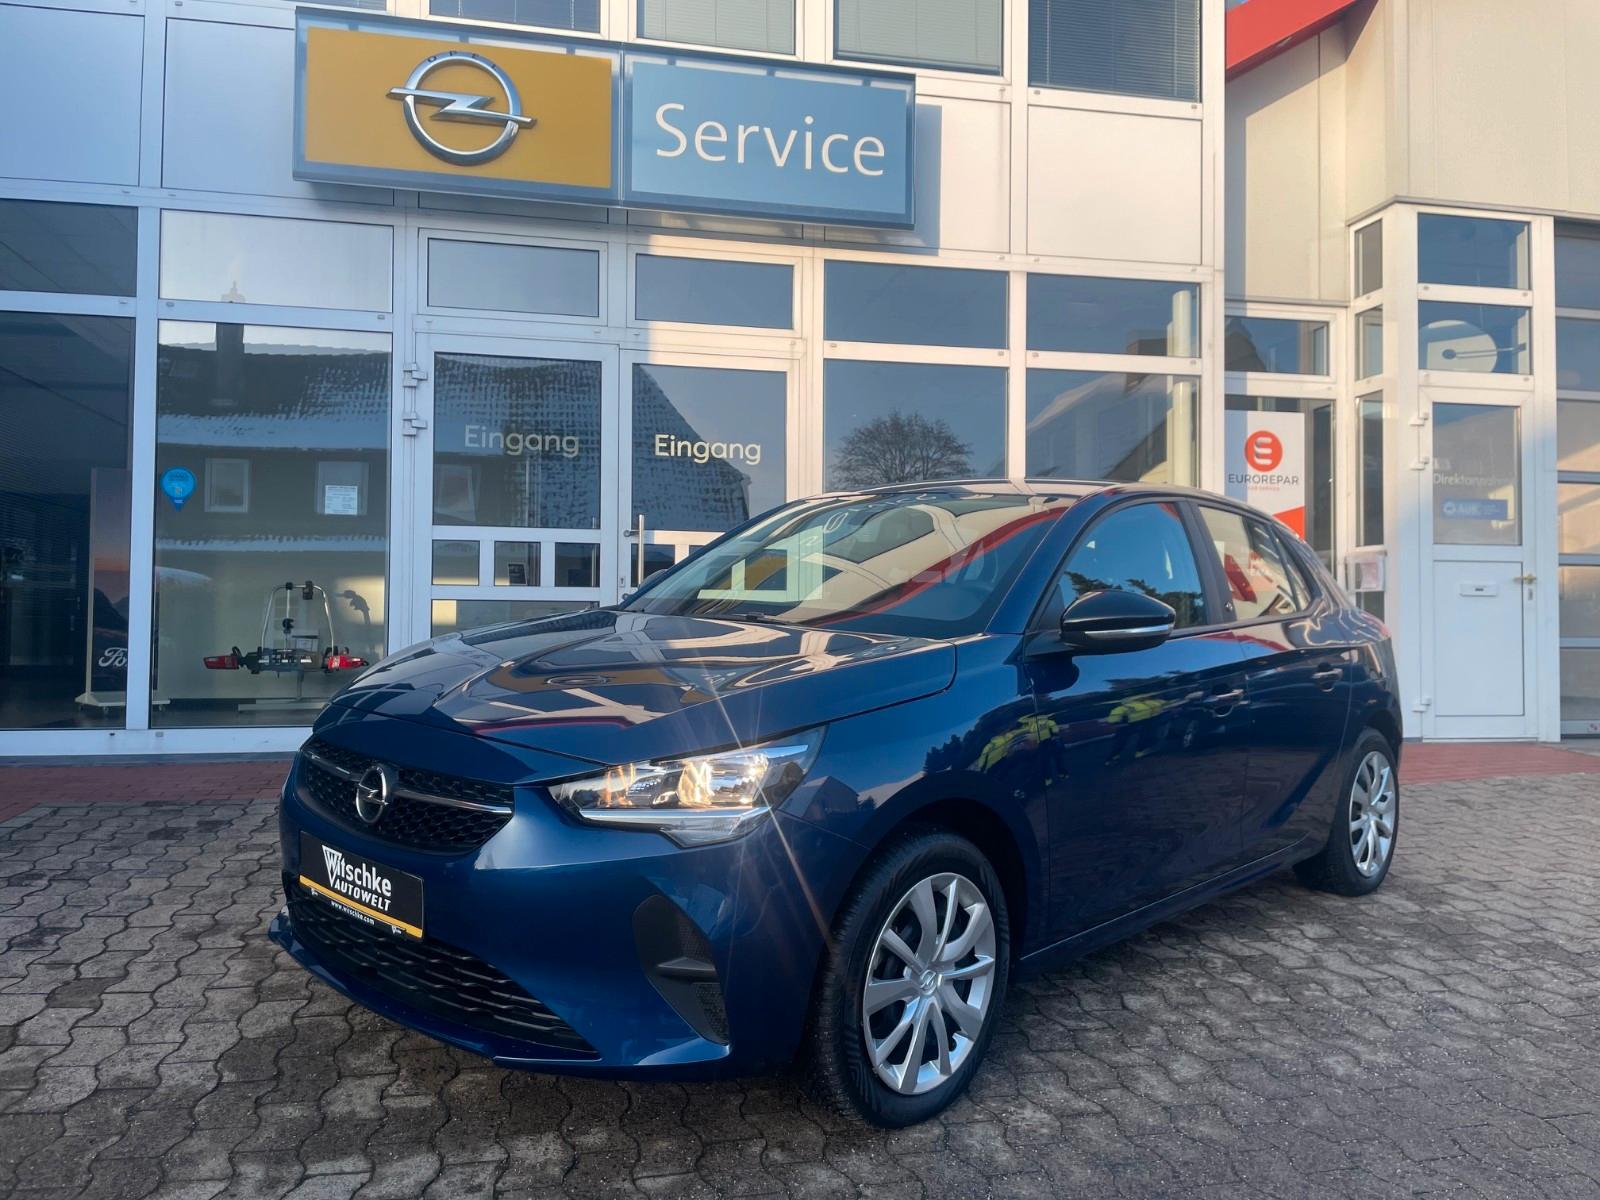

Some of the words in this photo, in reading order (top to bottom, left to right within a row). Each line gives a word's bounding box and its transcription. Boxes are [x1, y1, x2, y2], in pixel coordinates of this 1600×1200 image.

[655, 103, 885, 176] Service
[464, 424, 580, 458] Eingang
[654, 433, 761, 465] Eingang
[1227, 473, 1299, 485] EUROREPAR
[98, 647, 128, 667] Fo
[322, 845, 392, 897] Witschke
[334, 878, 392, 911] AUTOWELT
[330, 900, 375, 926] www.witschke.com
